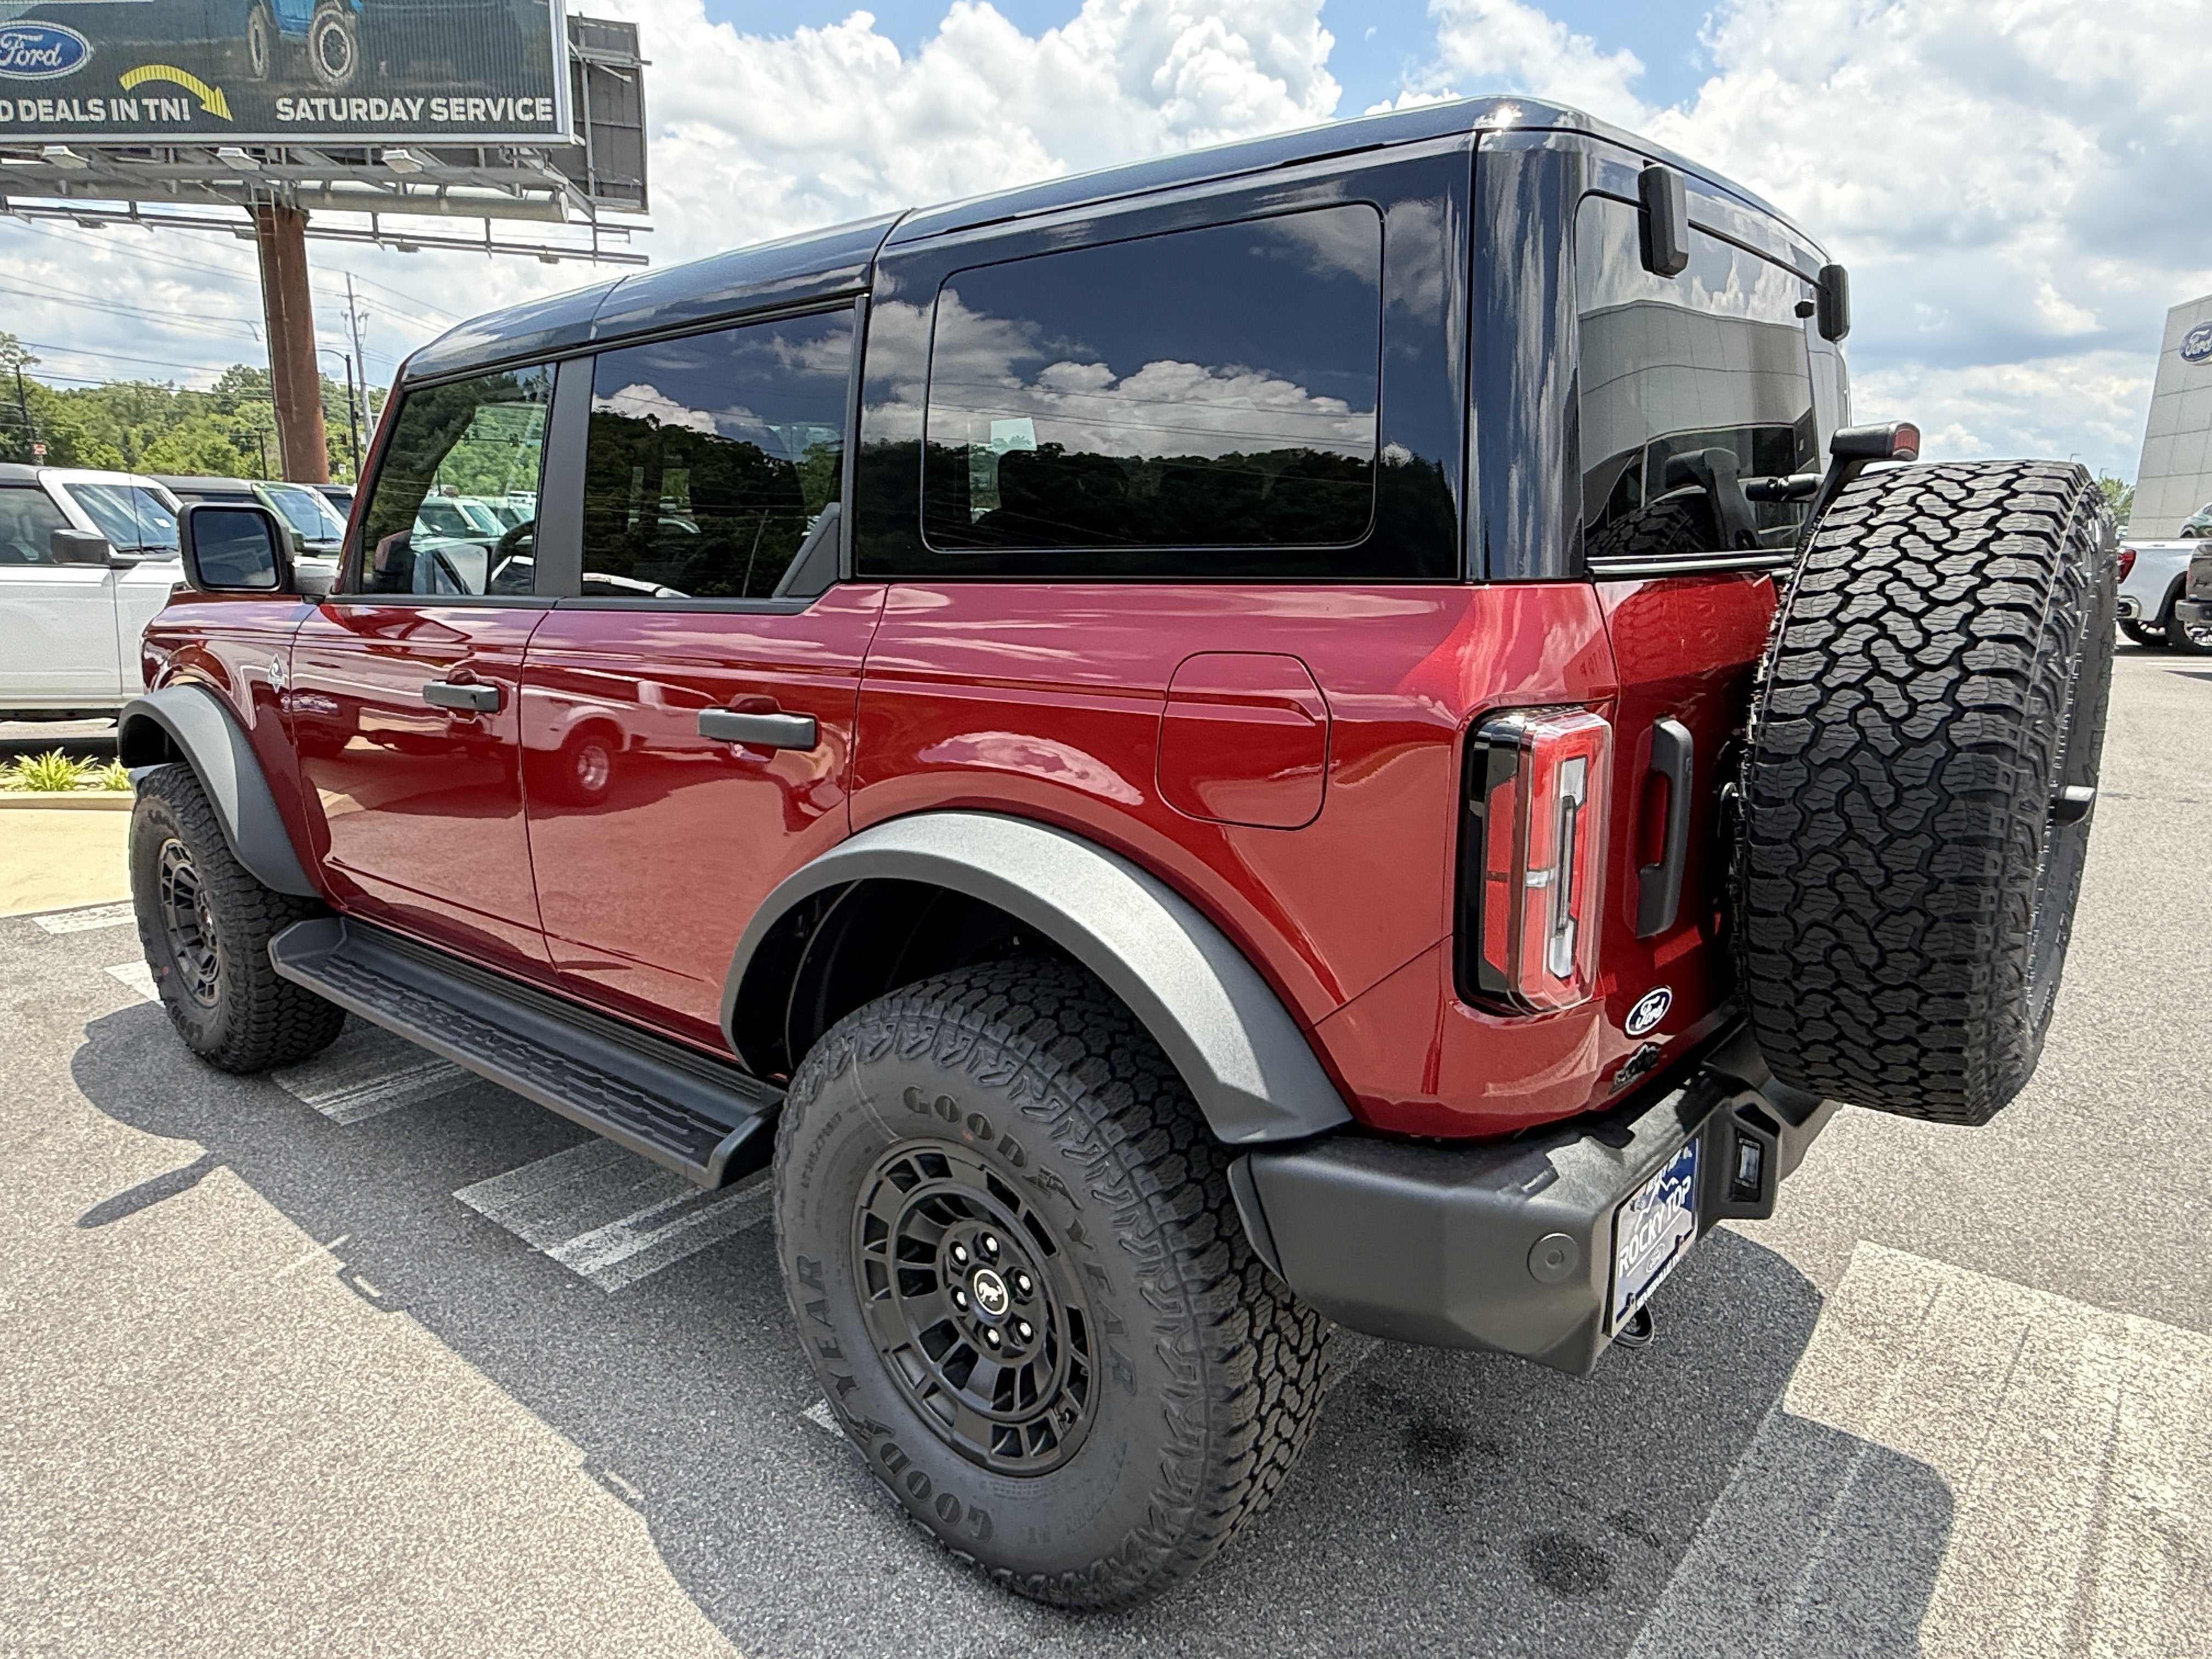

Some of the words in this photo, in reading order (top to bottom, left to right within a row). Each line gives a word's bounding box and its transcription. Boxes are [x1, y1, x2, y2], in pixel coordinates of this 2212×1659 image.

[0, 33, 62, 66] Ford
[18, 99, 106, 122] DEALS
[110, 99, 139, 121] IN
[142, 98, 190, 121] TN!
[275, 97, 425, 122] SATURDAY
[430, 97, 554, 122] SERVICE
[1635, 995, 1666, 1029] Ford
[1619, 1204, 1666, 1278] ROCKY
[1666, 1175, 1691, 1221] TOP
